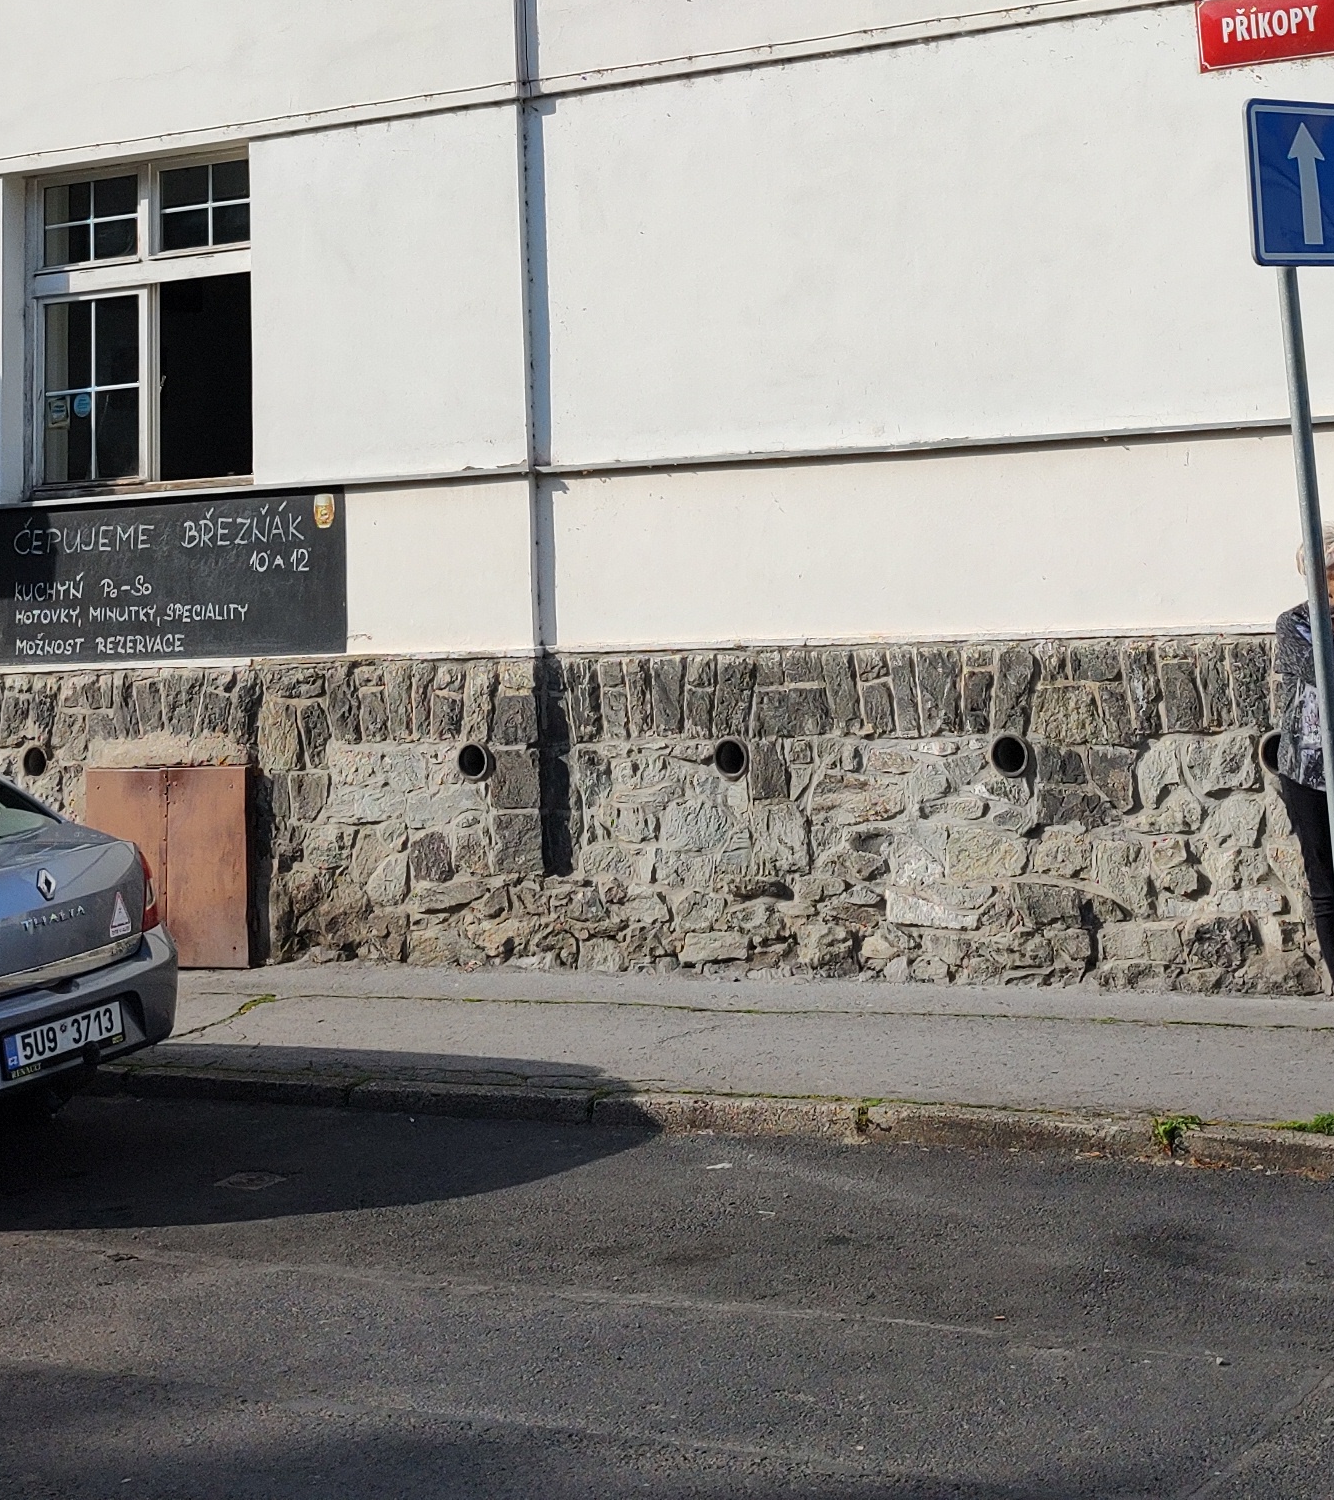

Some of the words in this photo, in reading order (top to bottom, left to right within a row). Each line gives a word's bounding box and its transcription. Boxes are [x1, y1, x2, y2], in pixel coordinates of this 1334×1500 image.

[1221, 5, 1319, 43] PŘÍKOPY
[14, 517, 155, 555] ČEPUJEME
[181, 500, 305, 548] BŘEZŇÁK
[14, 572, 84, 602] KUCHYŇ
[163, 602, 248, 622] SPECIALITY
[15, 632, 84, 656] MOŽNOST
[95, 634, 184, 655] REZERVACE
[21, 1026, 58, 1061] 5U9
[71, 1007, 114, 1045] 3713
